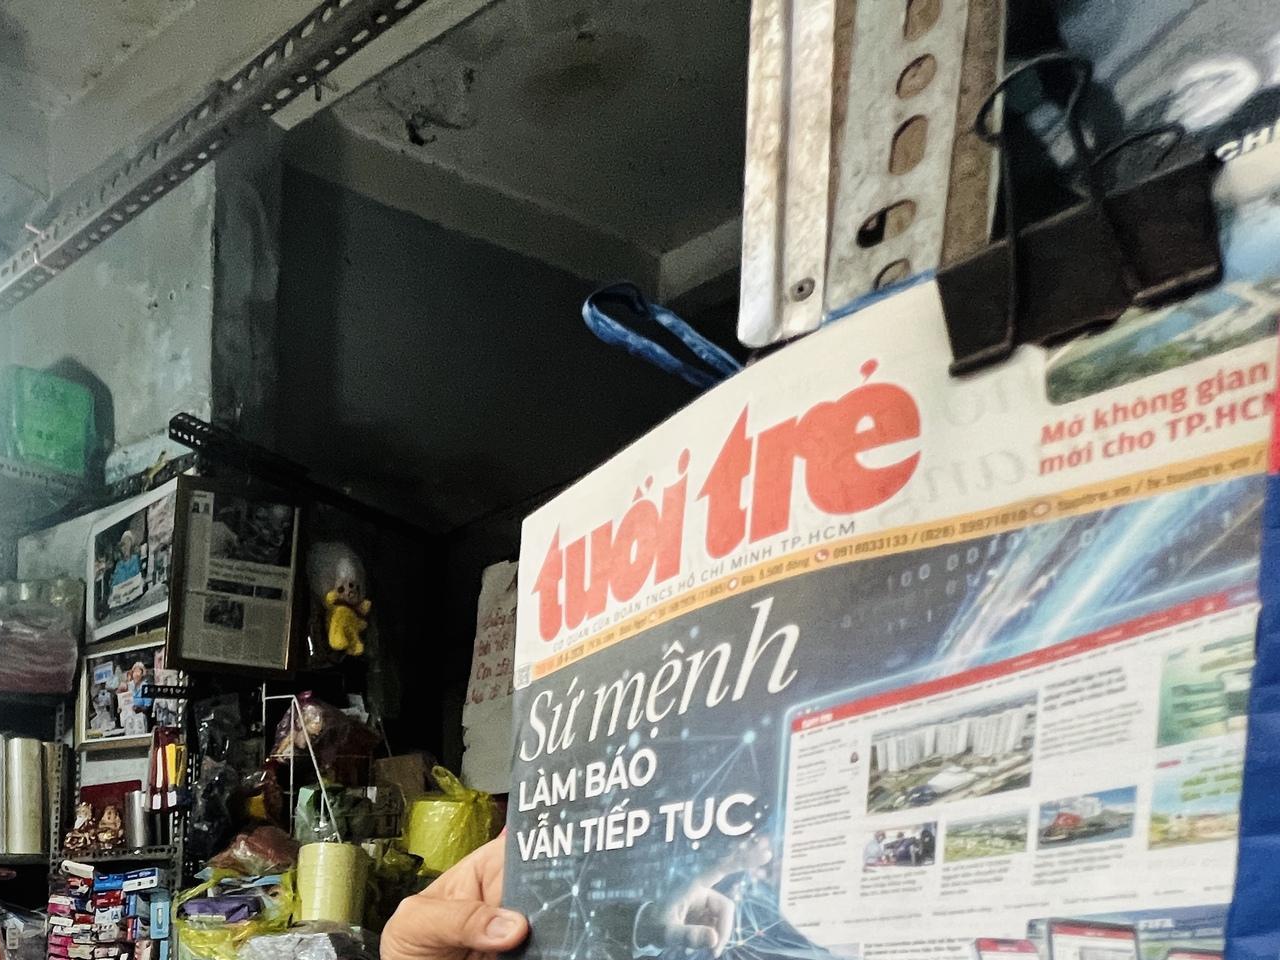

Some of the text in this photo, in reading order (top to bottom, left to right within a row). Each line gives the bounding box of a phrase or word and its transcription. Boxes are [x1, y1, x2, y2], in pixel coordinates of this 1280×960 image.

[1093, 386, 1187, 429] không
[1197, 362, 1269, 406] gian
[1038, 440, 1093, 476] mới
[1102, 430, 1156, 459] cho
[531, 359, 921, 642] tuổi trẻ
[730, 543, 772, 570] MINH
[781, 520, 856, 552] TP.HCM
[519, 676, 585, 762] Sứ
[588, 597, 800, 742] mệnh
[518, 744, 657, 812] LÀM BÁO
[517, 793, 757, 861] VẪN TIẾP TỤC
